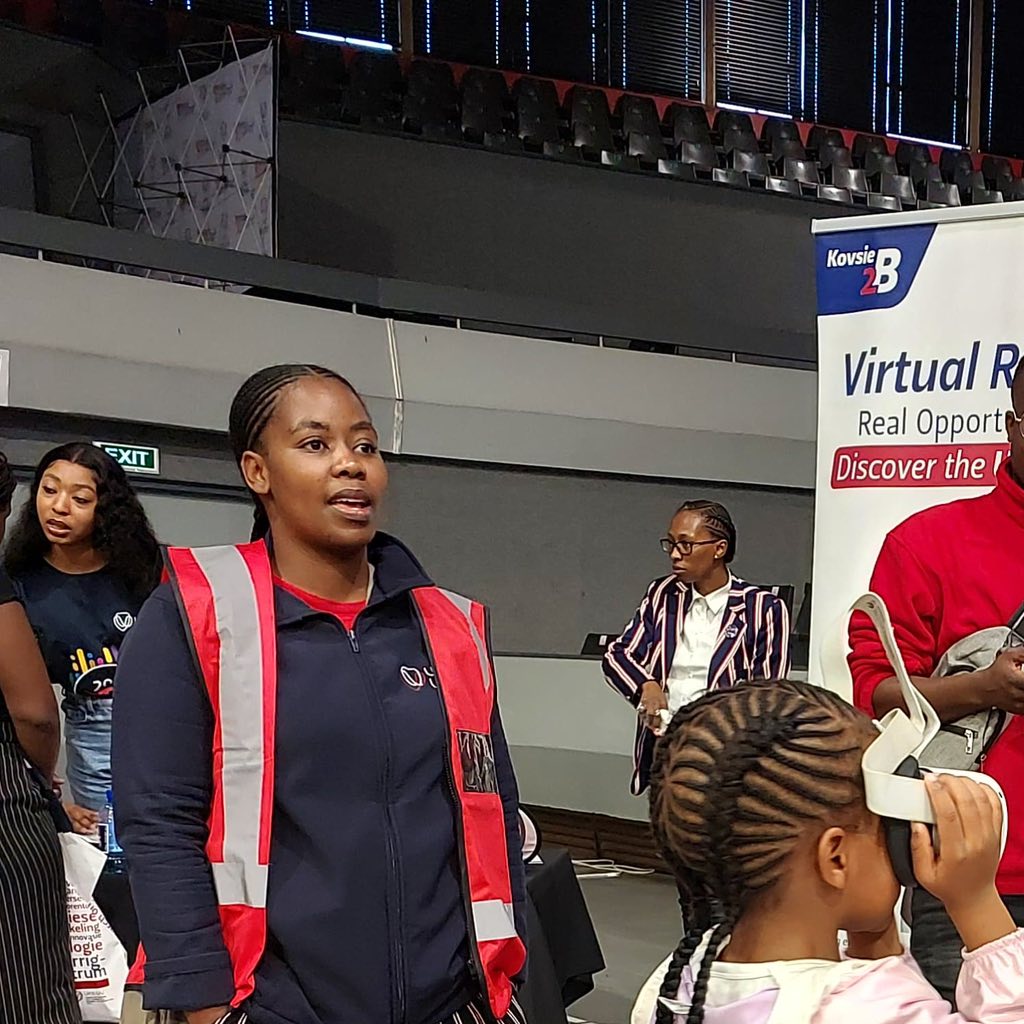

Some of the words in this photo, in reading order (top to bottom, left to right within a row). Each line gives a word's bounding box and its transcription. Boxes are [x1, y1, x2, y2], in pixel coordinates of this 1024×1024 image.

[826, 244, 876, 268] Kovsie
[845, 340, 981, 397] Virtual
[858, 406, 907, 437] Real
[917, 408, 1003, 443] Opport
[836, 452, 938, 481] Discover
[944, 449, 986, 479] the
